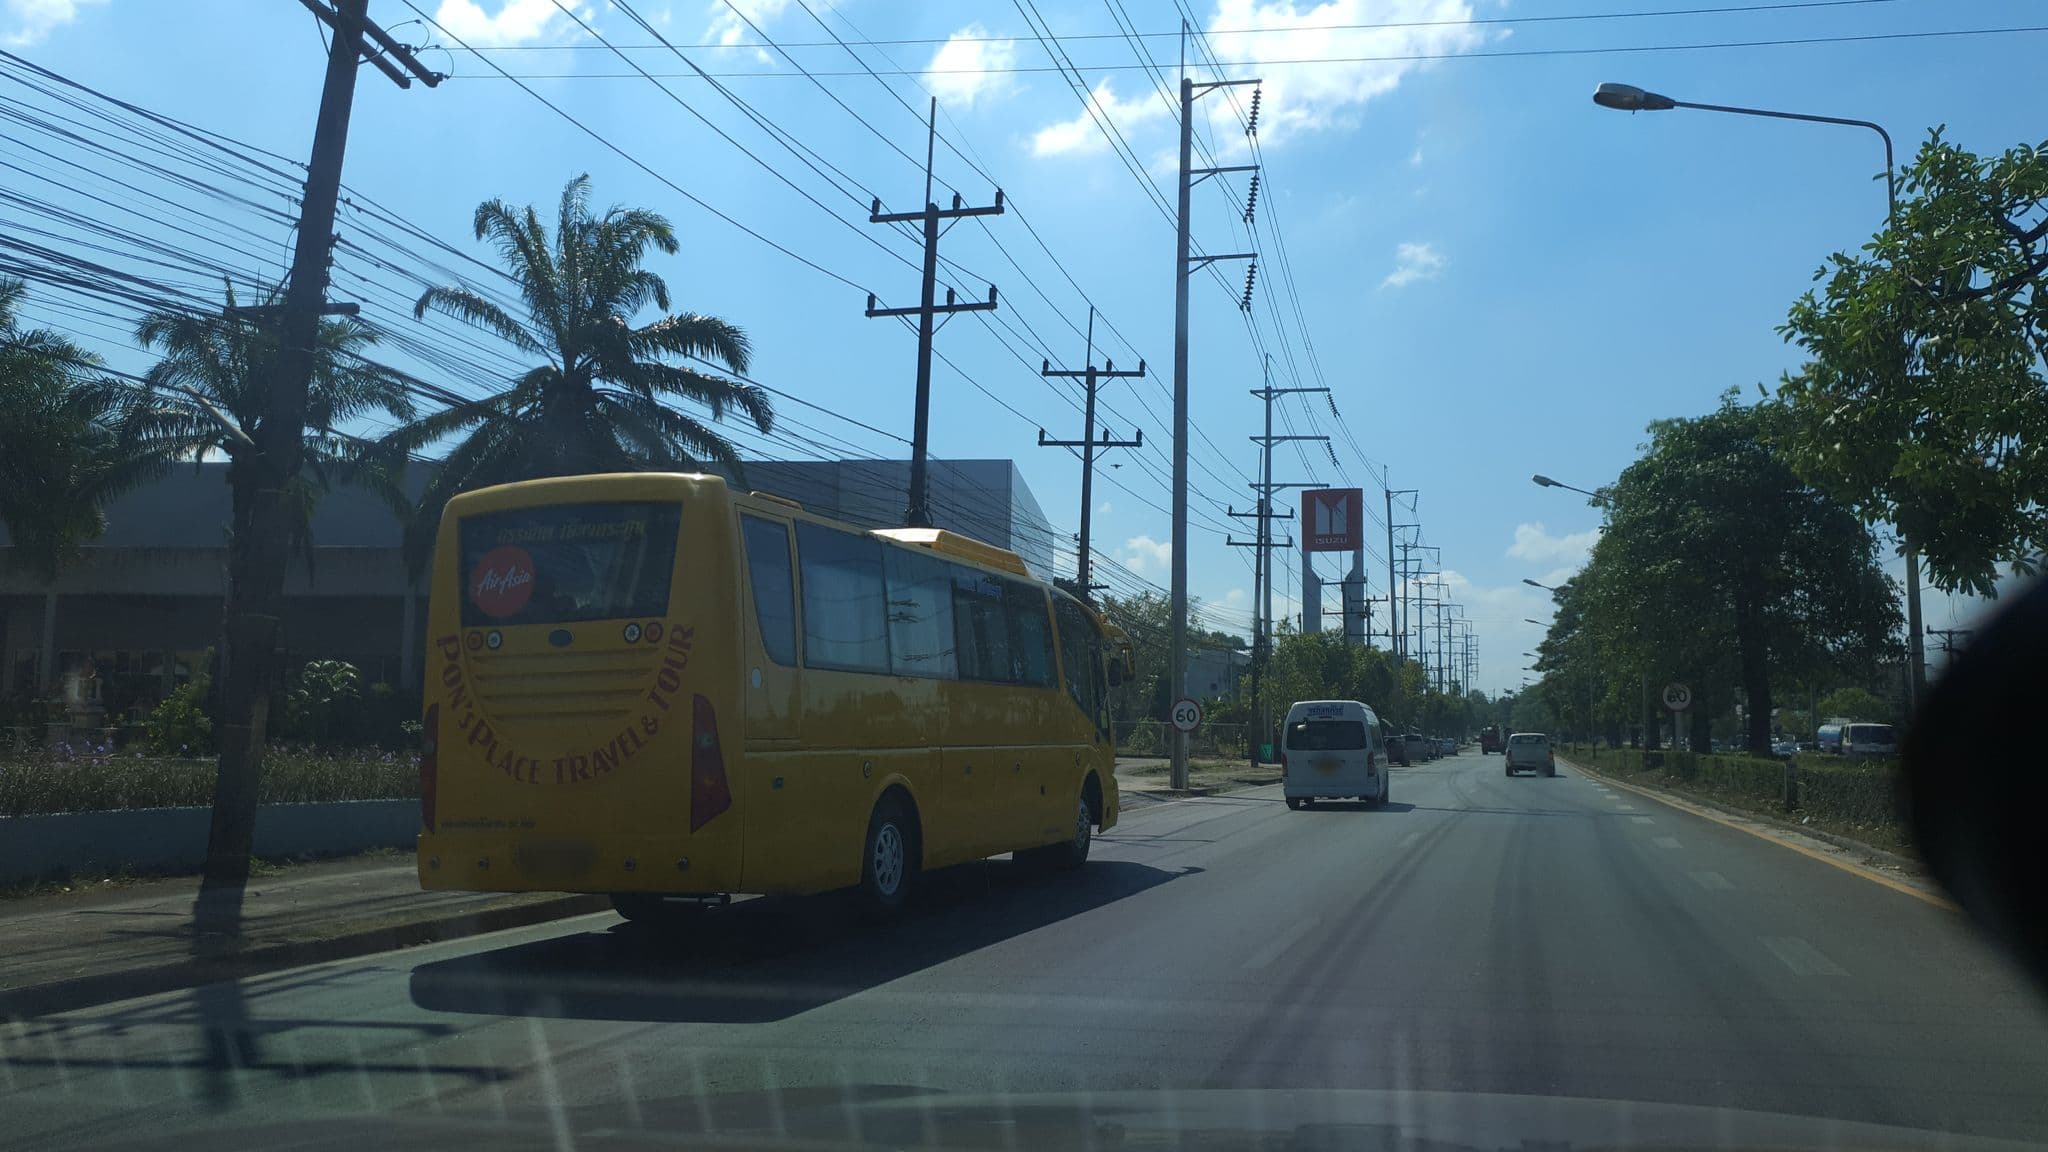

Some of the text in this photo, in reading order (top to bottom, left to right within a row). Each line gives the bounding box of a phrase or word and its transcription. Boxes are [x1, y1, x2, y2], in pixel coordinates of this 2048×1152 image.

[1315, 536, 1347, 544] ISUZU
[478, 566, 530, 595] AirAsia
[437, 624, 695, 784] PON'S PLACE TRAVEL & TOUR
[1176, 708, 1196, 723] 60
